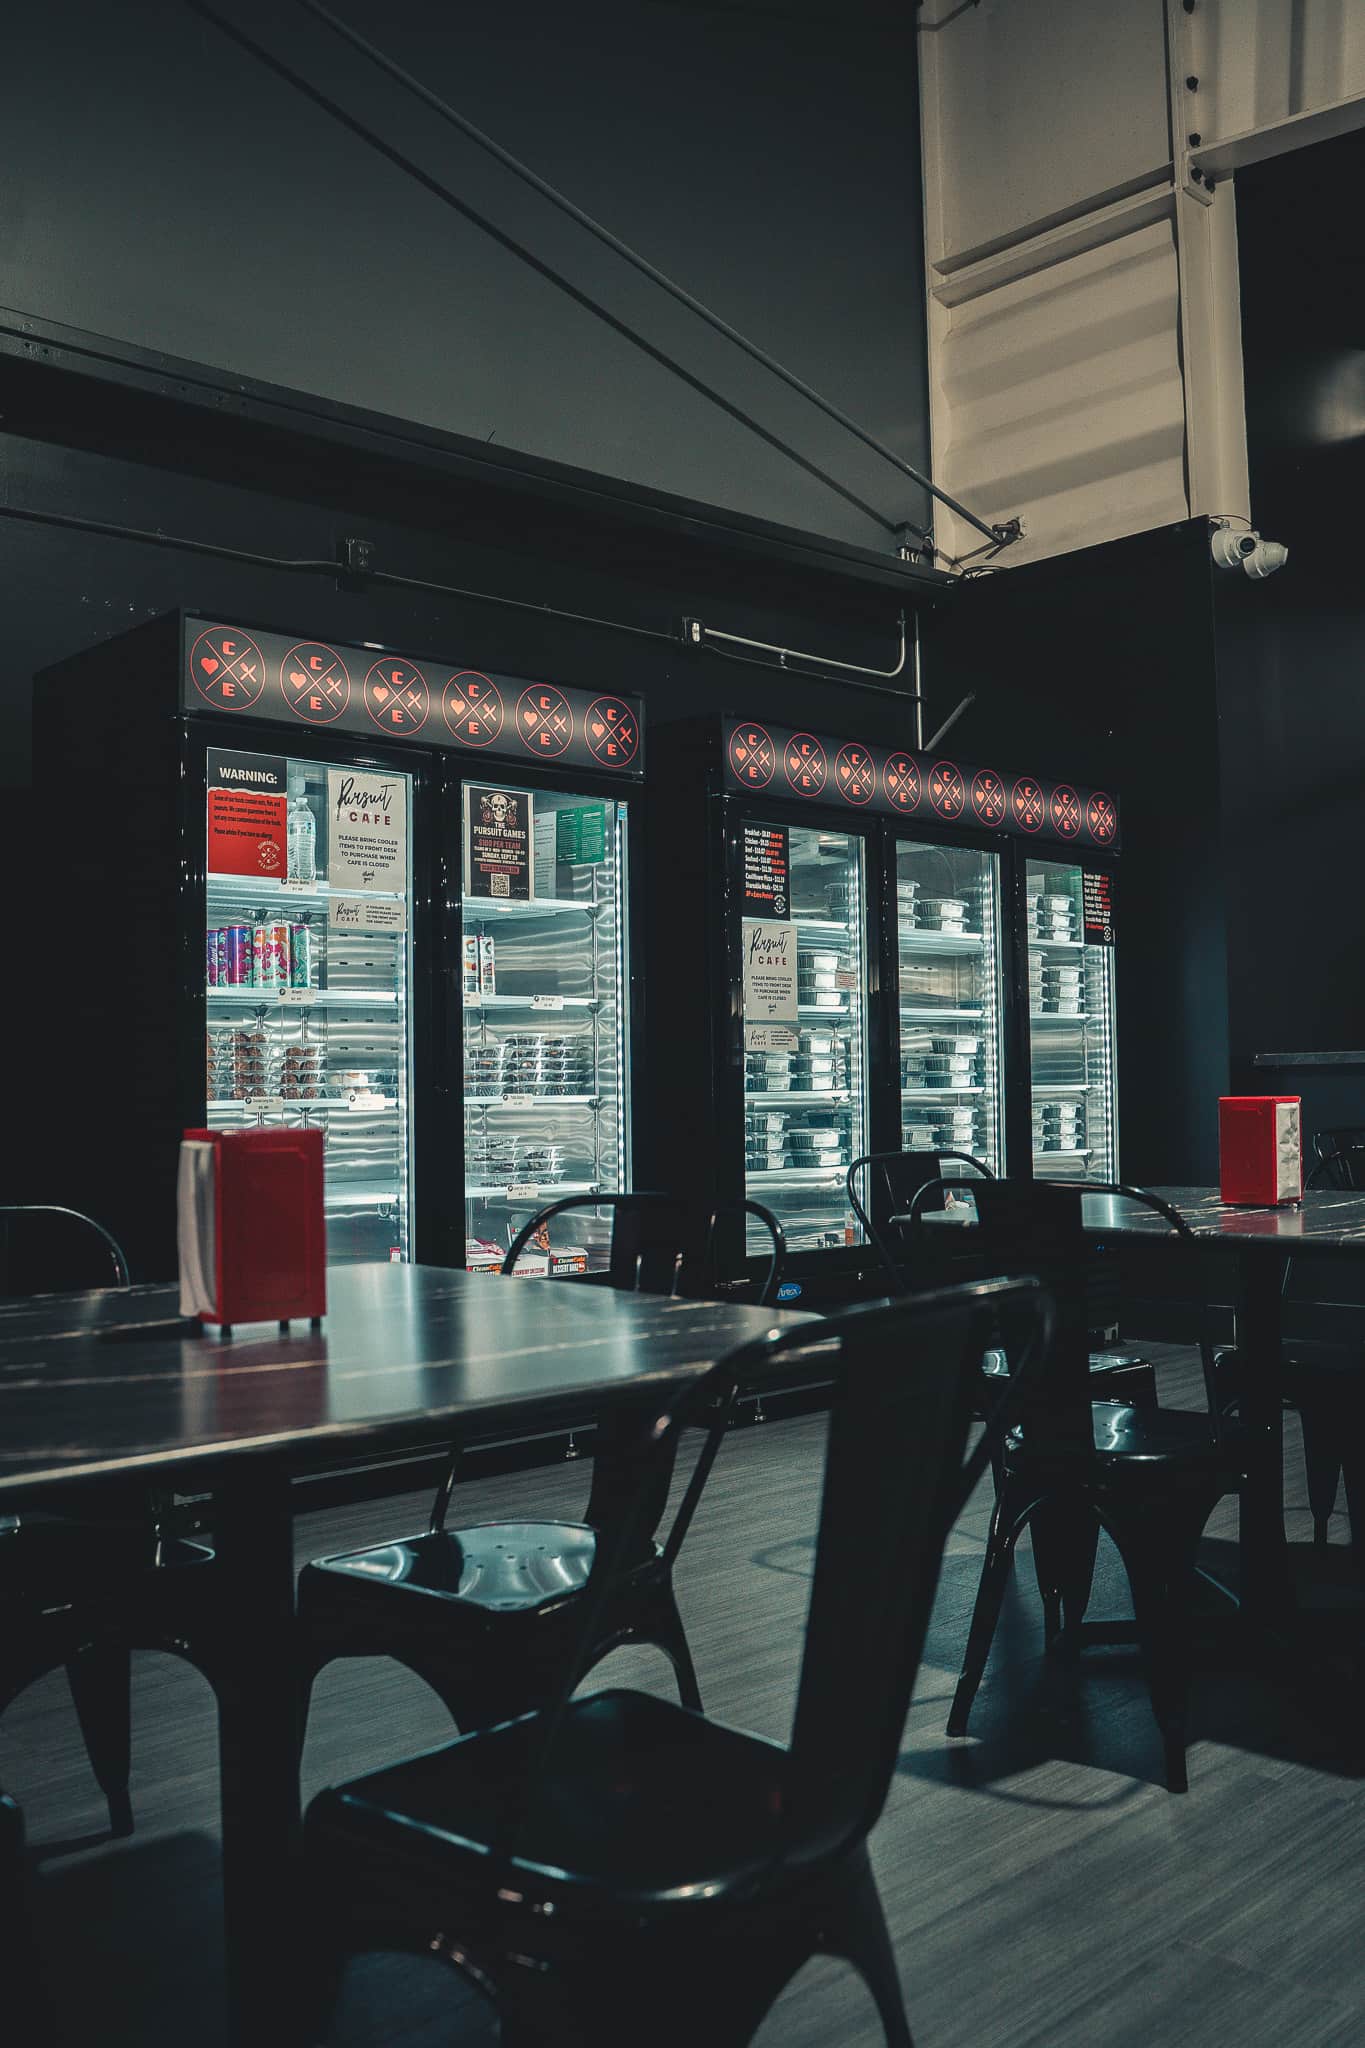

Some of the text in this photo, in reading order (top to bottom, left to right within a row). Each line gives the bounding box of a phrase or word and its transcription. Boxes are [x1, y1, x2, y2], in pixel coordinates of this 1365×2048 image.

[219, 767, 278, 784] WARNING:
[337, 777, 398, 821] Pursuit
[350, 812, 391, 826] CAFE
[473, 826, 526, 839] PURSUIT GAMES
[377, 838, 398, 846] COOLER
[749, 927, 791, 965] Pursuit
[758, 956, 787, 966] CAFE
